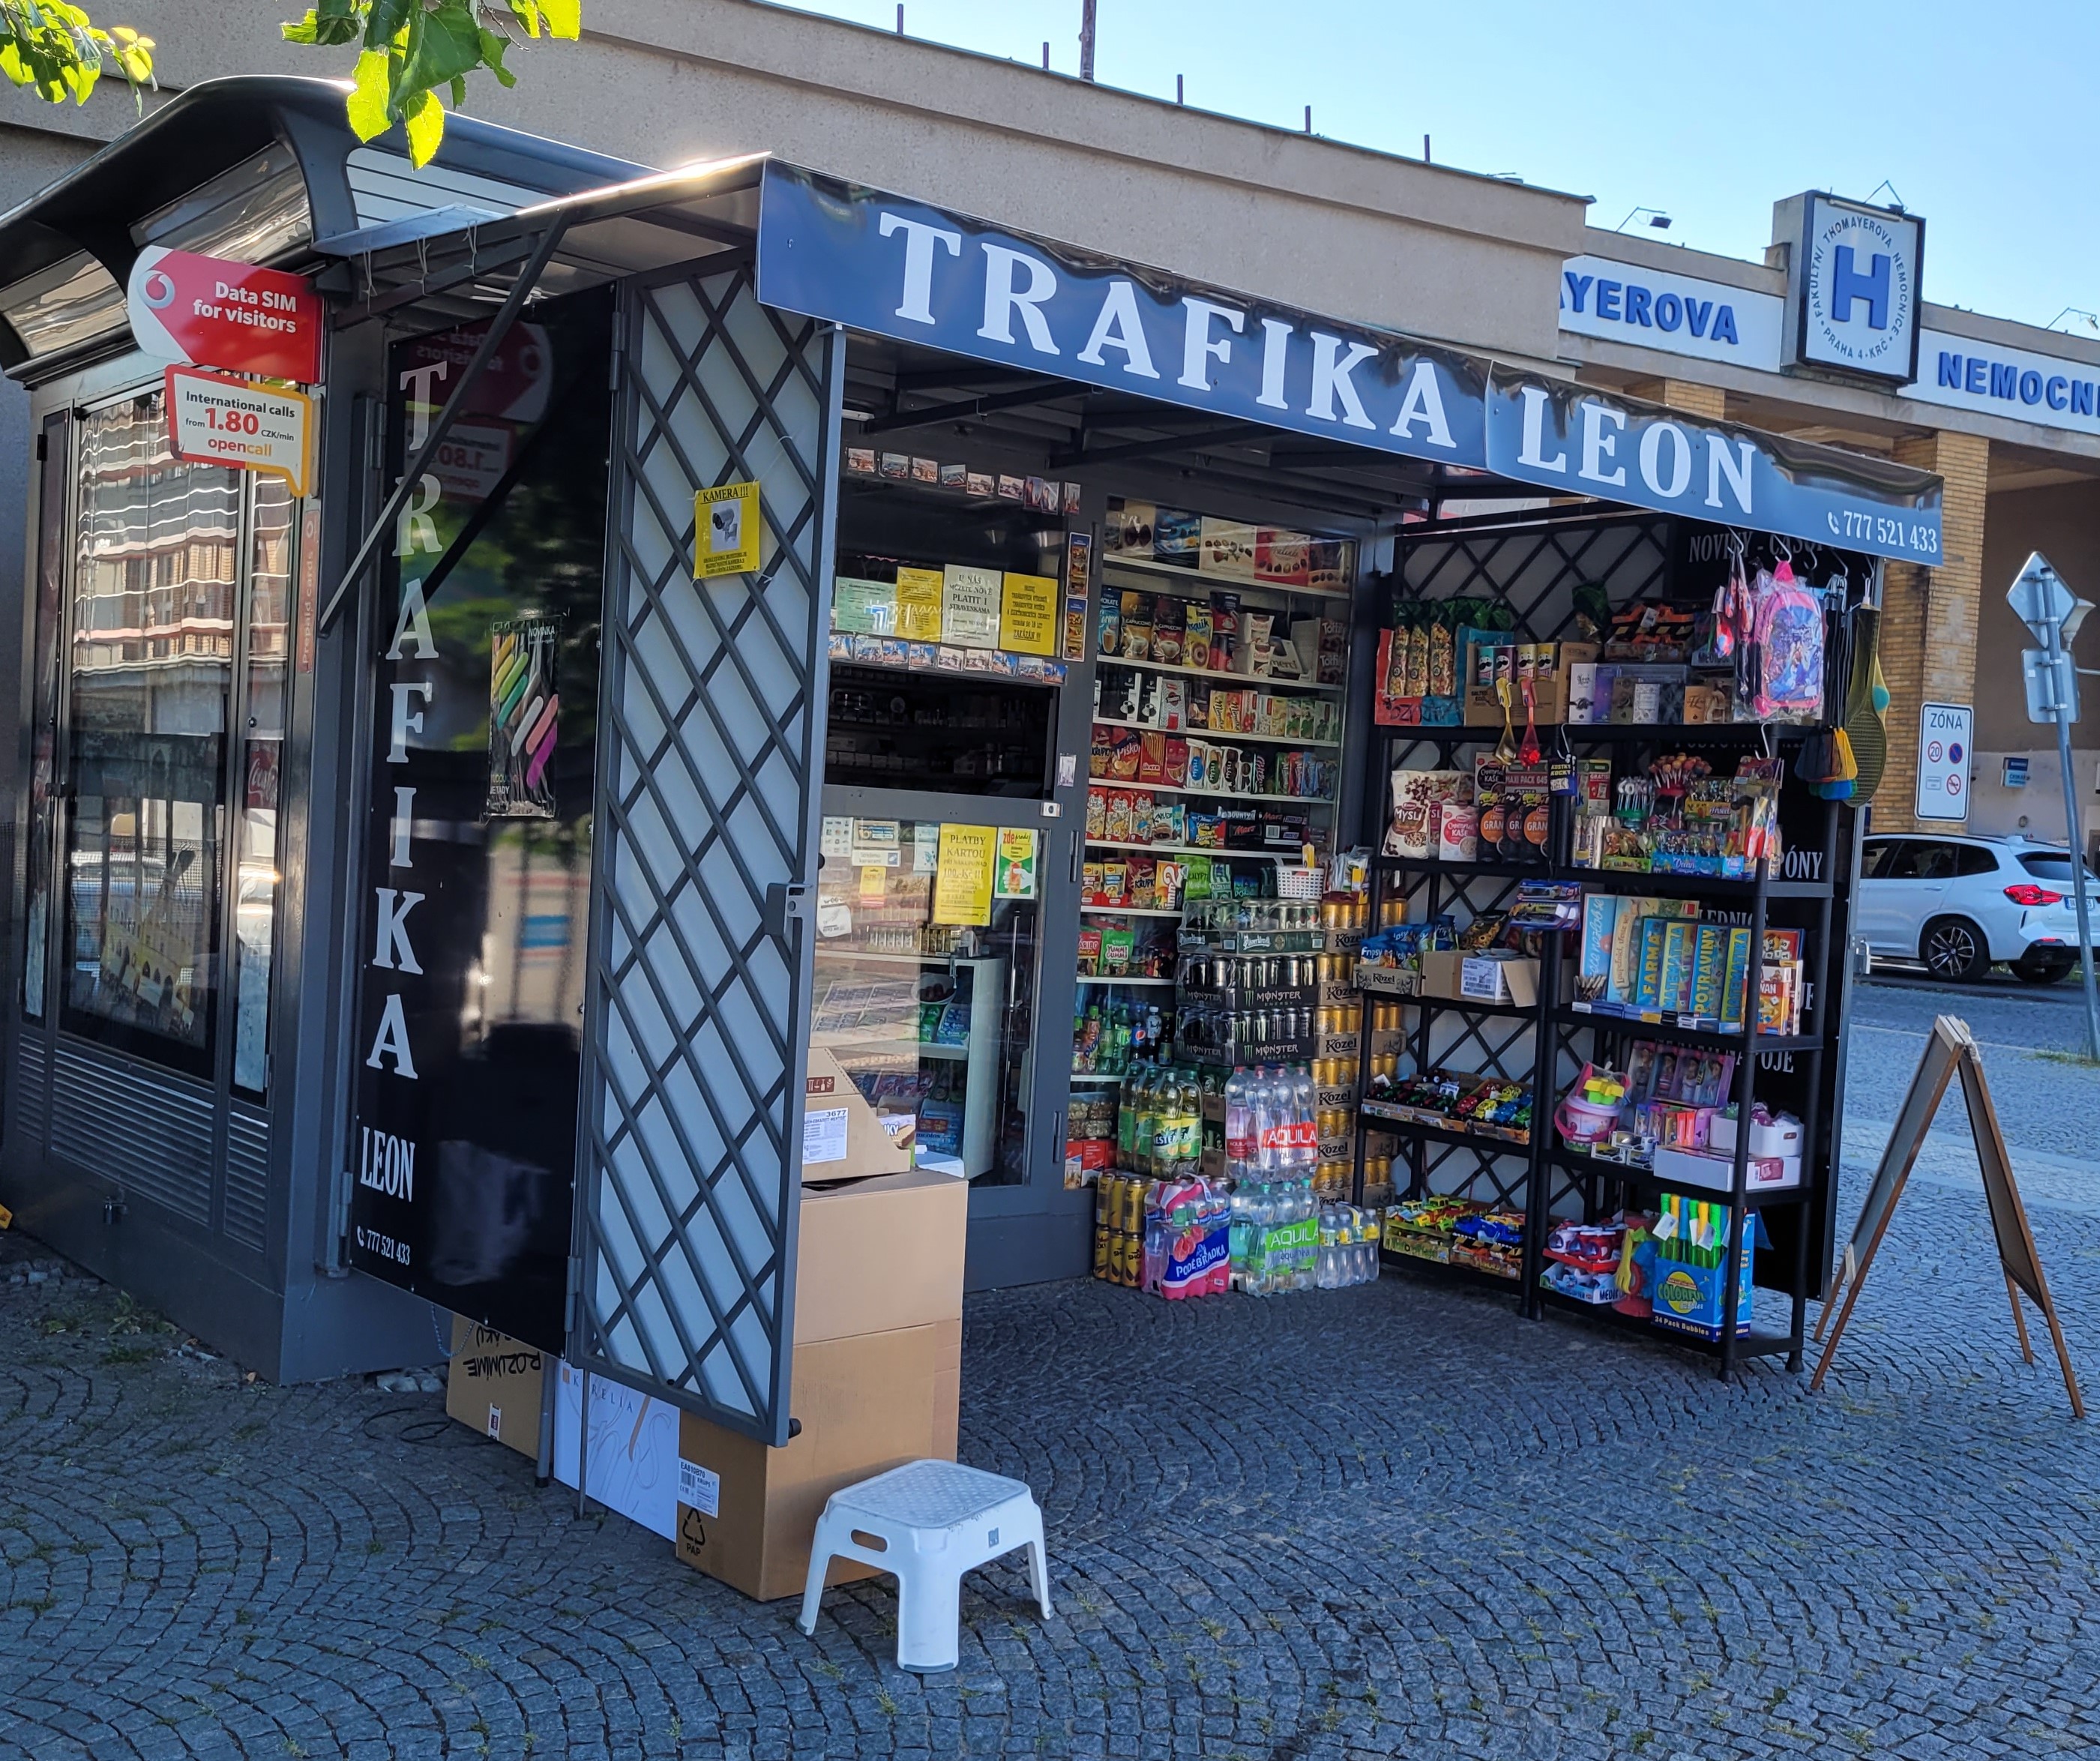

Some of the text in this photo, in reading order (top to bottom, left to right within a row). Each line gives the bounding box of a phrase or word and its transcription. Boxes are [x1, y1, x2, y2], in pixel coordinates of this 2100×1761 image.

[1810, 216, 1908, 336] FAKULTNÍ THOMAYEROVA NEMOCNICE
[215, 281, 297, 313] Data SIM
[1832, 244, 1891, 330] H
[193, 300, 297, 333] for visitors
[1559, 271, 1739, 345] YEROVA
[879, 211, 1457, 448] TRAFIKA
[1823, 327, 1853, 358] PRAHA
[186, 391, 295, 418] International calls
[186, 408, 295, 442] from 1.80 CZK/min
[208, 436, 272, 457] opencall
[1517, 385, 1757, 514] LEON
[703, 485, 749, 502] KAMERA !!!
[1843, 510, 1937, 554] 777 521 433
[1688, 531, 1754, 562] NOVINY
[952, 593, 981, 606] PLATIT
[303, 600, 311, 663] Prepaid
[528, 625, 556, 636] NOVINKA
[1930, 711, 1963, 730] ZÓNA
[1931, 747, 1940, 758] 20
[1395, 807, 1421, 822] MYSLI
[1235, 825, 1256, 834] Mars
[1484, 820, 1503, 830] GRAN
[1527, 822, 1547, 831] GRAN
[950, 834, 987, 846] PLATBY
[1003, 830, 1015, 845] zde
[947, 847, 986, 858] KARTOU
[1780, 844, 1823, 880] ÓNY
[1079, 940, 1099, 950] ARIBO
[1335, 933, 1365, 948] Kozel
[1643, 934, 1661, 995] FARMA
[1663, 926, 1685, 1010] MATEMATIKA
[1694, 929, 1716, 1014] POTRAVINY
[1372, 972, 1395, 984] Kozel
[1726, 932, 1749, 1018] MATEMATIKA
[1257, 990, 1302, 1002] MONSTER
[1255, 1043, 1299, 1056] MONSTER
[1325, 1038, 1357, 1053] Kozel
[1318, 1090, 1351, 1106] Kozel
[1267, 1128, 1317, 1146] AQUILA
[1317, 1141, 1349, 1158] Kozel
[360, 1126, 415, 1202] LEON
[367, 1229, 411, 1265] 777 521 433
[1270, 1228, 1319, 1248] AQUILA
[1176, 1244, 1226, 1277] PODĚBRADKA
[1658, 1283, 1706, 1301] COLORFUL
[1655, 1316, 1709, 1336] 24 Pack Bubbles
[463, 1351, 541, 1381] ROZUMÍME
[573, 1374, 633, 1413] KRELIA
[686, 1542, 702, 1556] PAP
